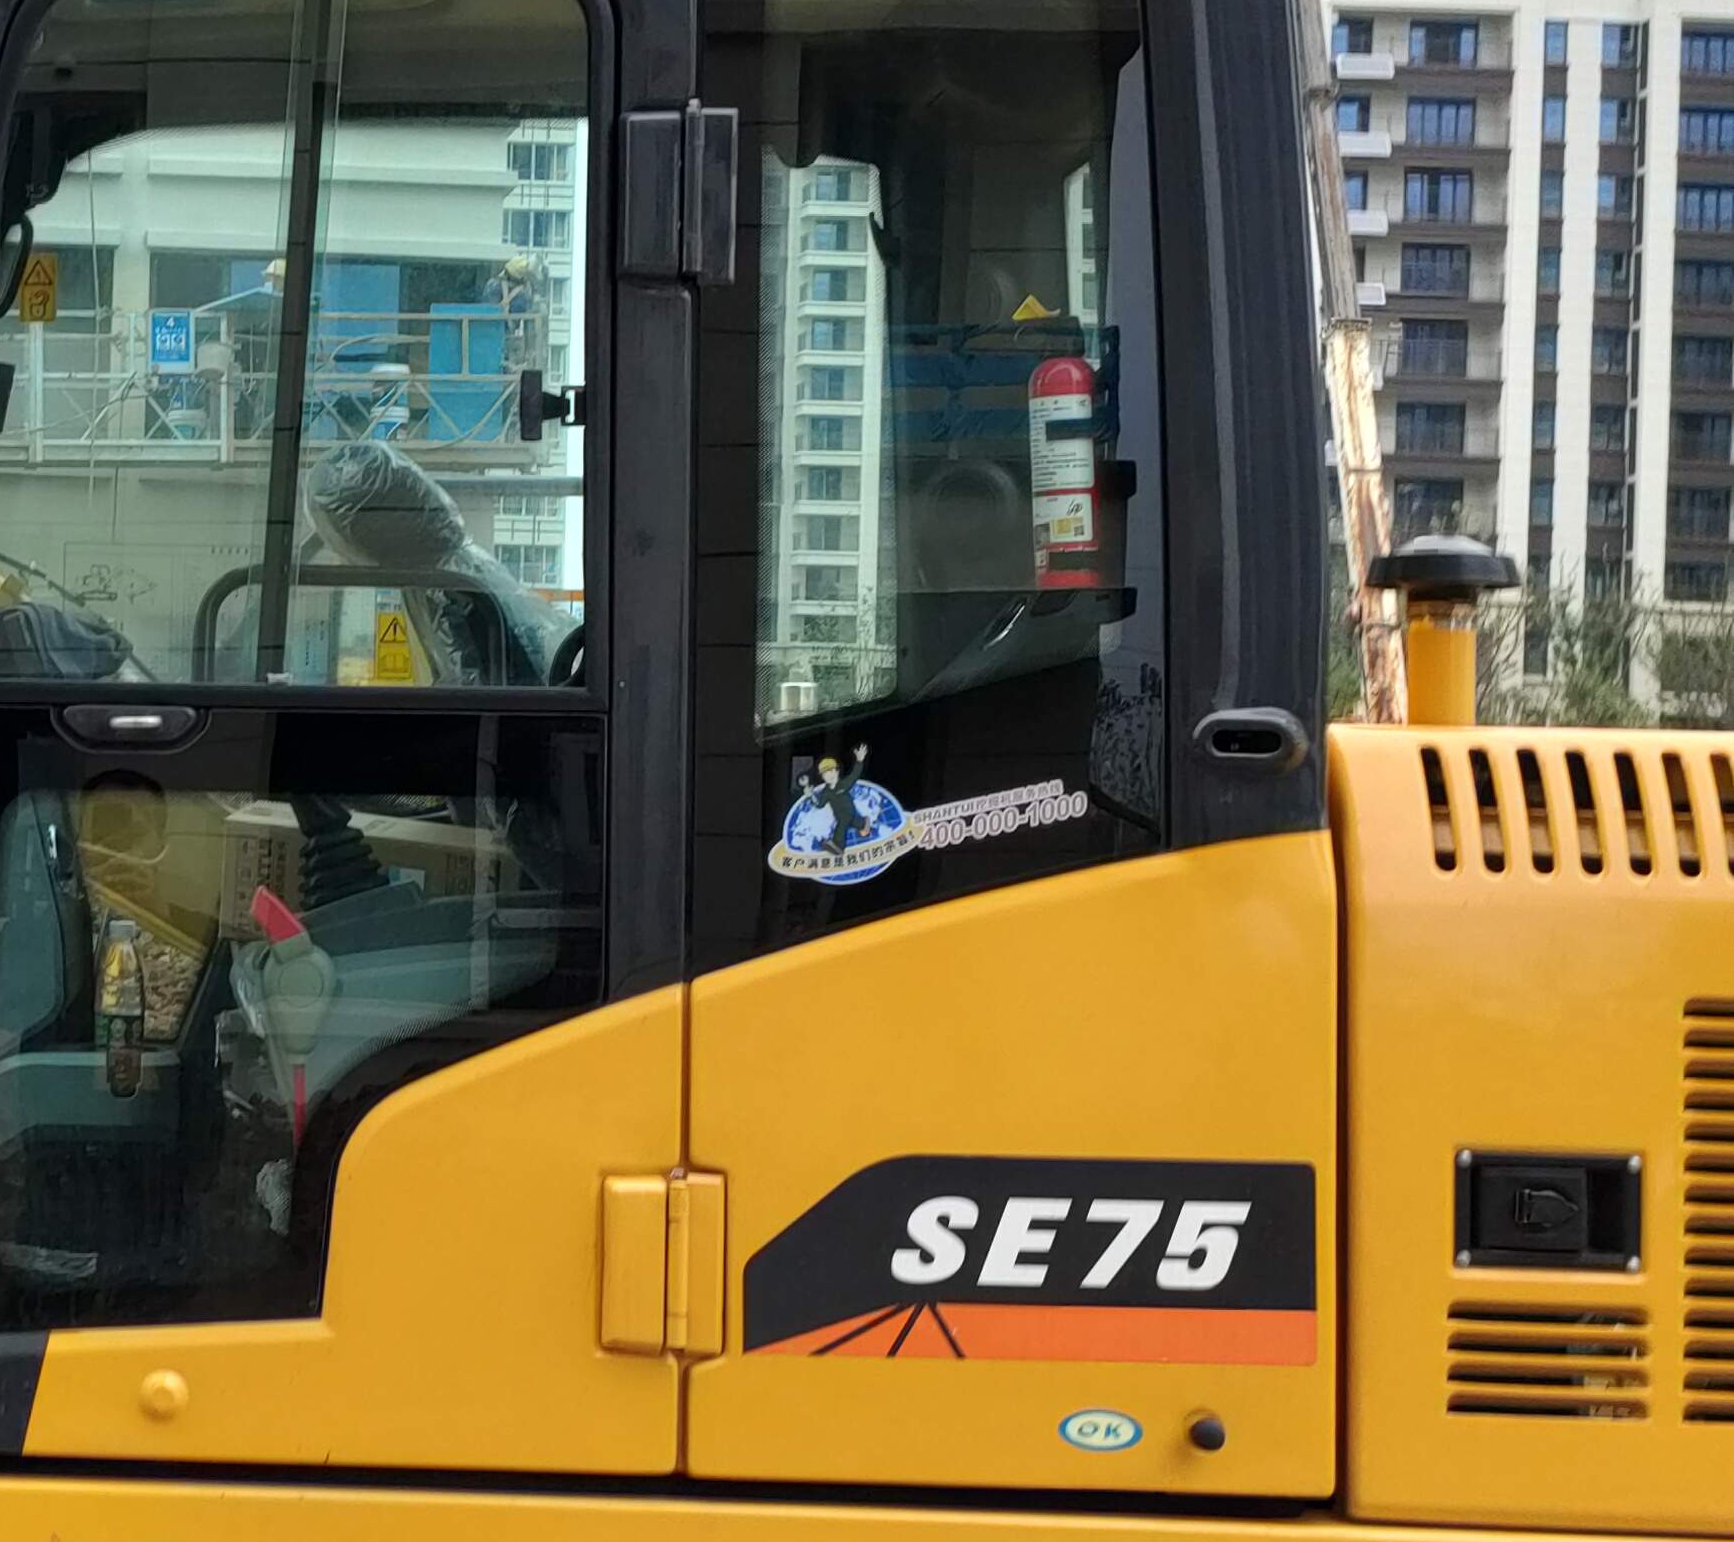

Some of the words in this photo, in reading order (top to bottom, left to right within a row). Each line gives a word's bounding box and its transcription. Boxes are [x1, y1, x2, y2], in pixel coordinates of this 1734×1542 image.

[919, 792, 1086, 848] 400-000-1000
[891, 1195, 1252, 1291] SE75
[1077, 1421, 1123, 1439] OK
